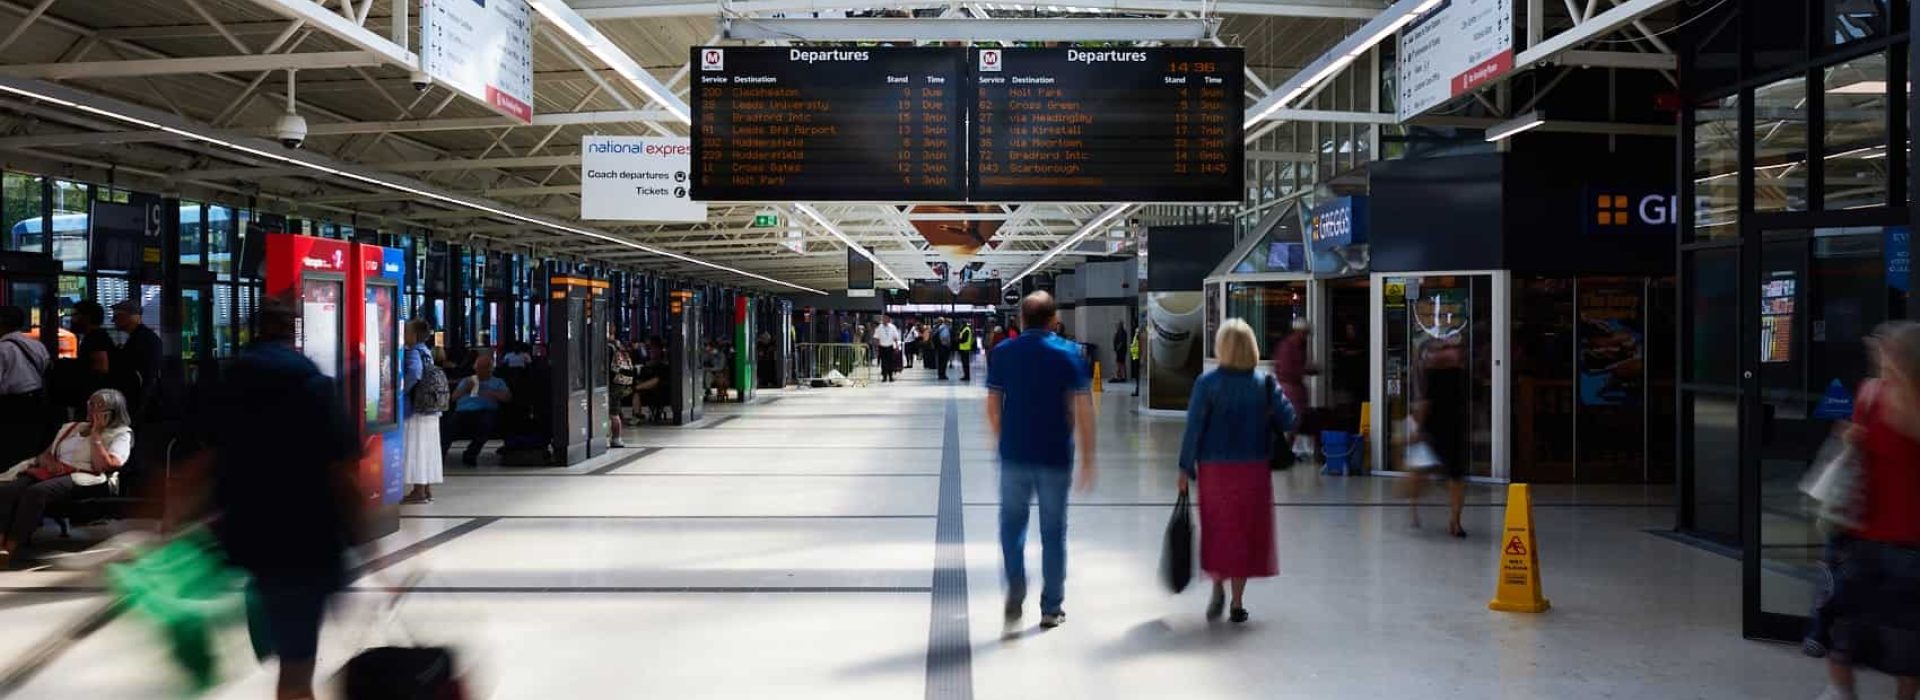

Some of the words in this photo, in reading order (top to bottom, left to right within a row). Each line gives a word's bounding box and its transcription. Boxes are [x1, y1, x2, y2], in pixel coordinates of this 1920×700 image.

[789, 49, 870, 64] Departures
[1067, 49, 1147, 64] Departures
[701, 75, 728, 84] Service
[733, 75, 777, 84] Destination
[887, 75, 909, 84] Stand
[927, 75, 945, 84] Time
[978, 76, 1005, 85] Service
[1011, 76, 1055, 85] Destination
[1164, 76, 1186, 84] Stand
[1204, 76, 1223, 84] Time
[922, 101, 943, 110] Due
[588, 140, 643, 153] national
[587, 169, 618, 178] Coach
[619, 170, 670, 180] departures
[636, 186, 669, 195] Tickets
[1319, 206, 1351, 240] GREGGS
